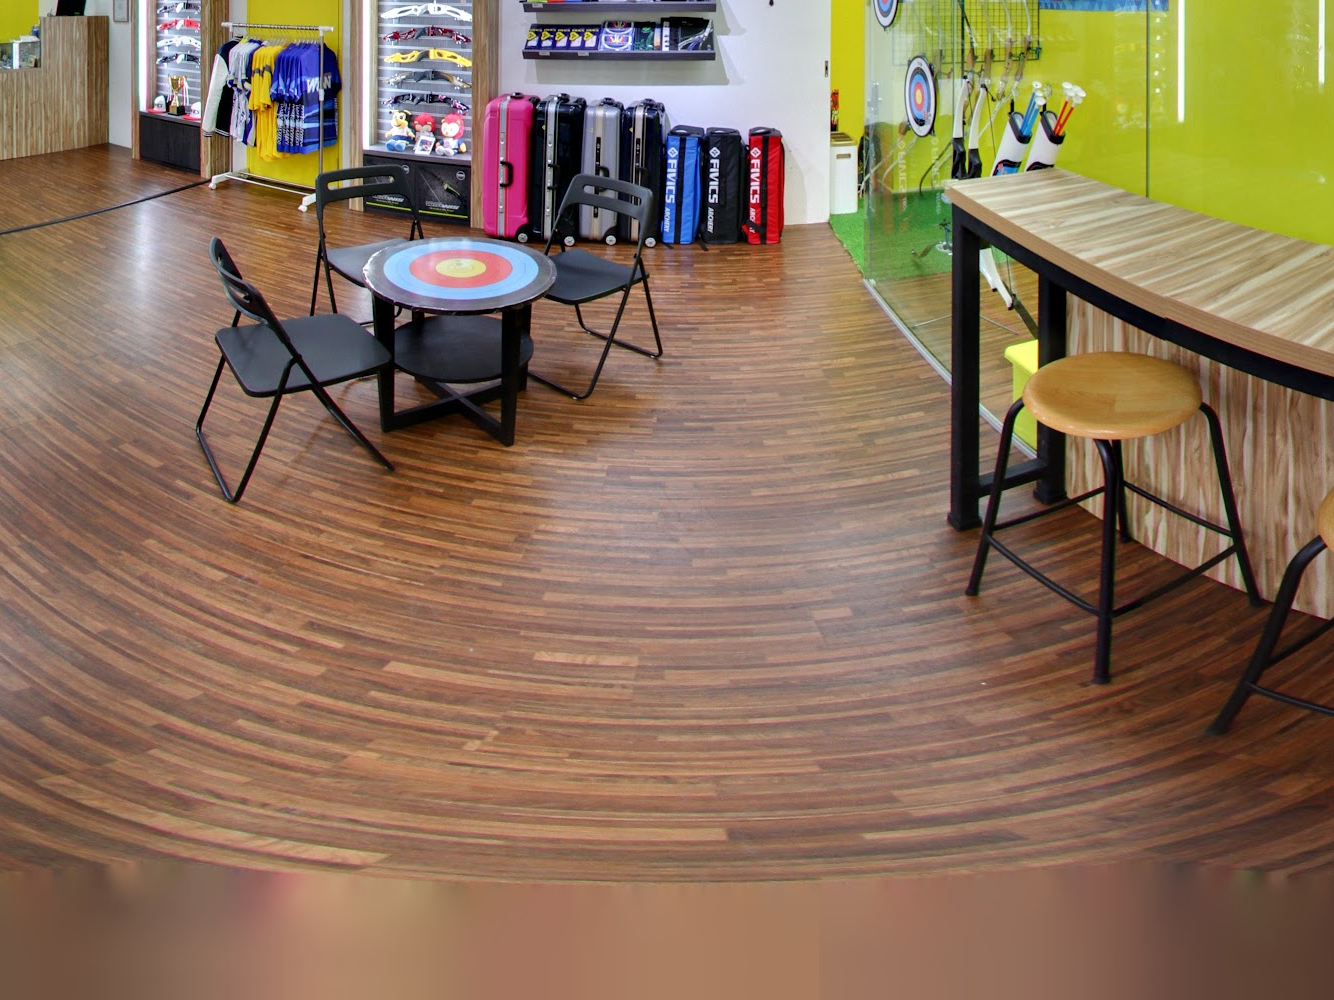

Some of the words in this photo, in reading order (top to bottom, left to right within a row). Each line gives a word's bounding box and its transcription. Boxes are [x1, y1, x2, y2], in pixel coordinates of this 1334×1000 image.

[665, 159, 678, 203] FIVICS
[708, 159, 720, 203] FIVICS
[750, 159, 761, 203] FIVICS
[663, 207, 671, 233] ARCHERY
